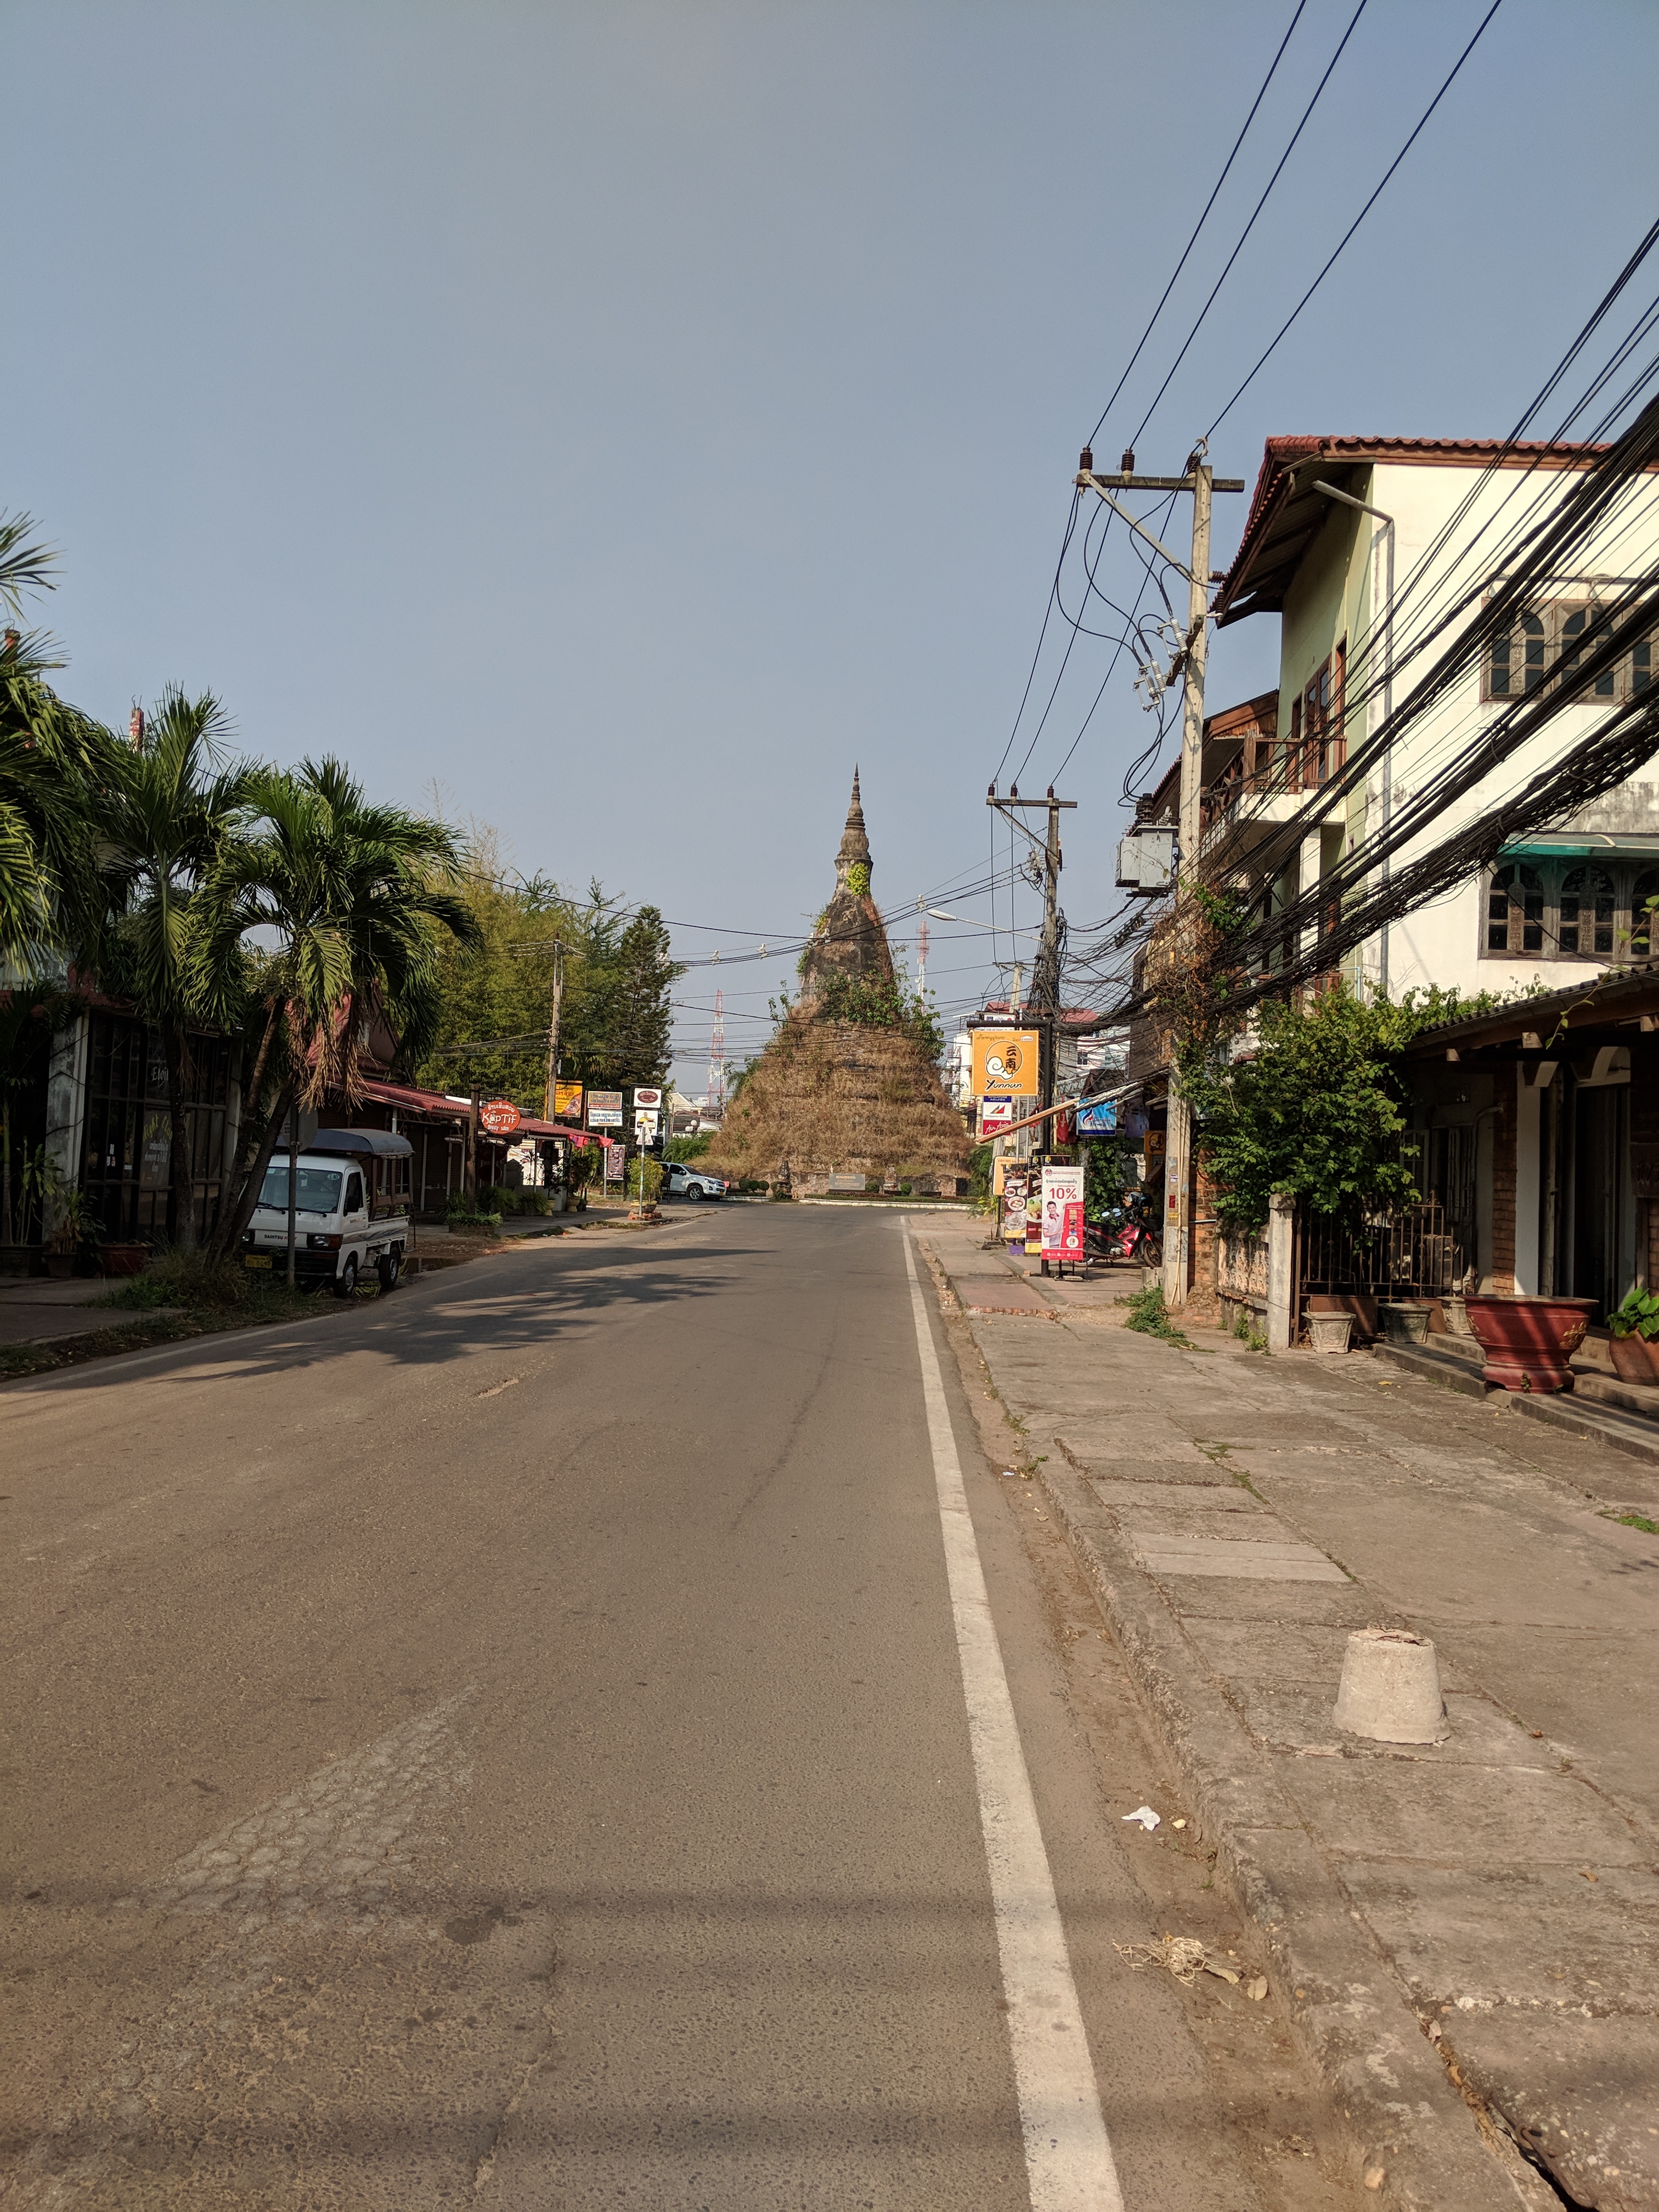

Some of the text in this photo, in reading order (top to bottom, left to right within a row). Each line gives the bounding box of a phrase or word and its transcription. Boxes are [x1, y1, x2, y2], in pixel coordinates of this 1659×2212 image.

[1006, 1045, 1017, 1070] 云南
[151, 1066, 168, 1081] Etoil
[985, 1079, 1022, 1091] Yunnan
[1049, 1187, 1077, 1199] 10%
